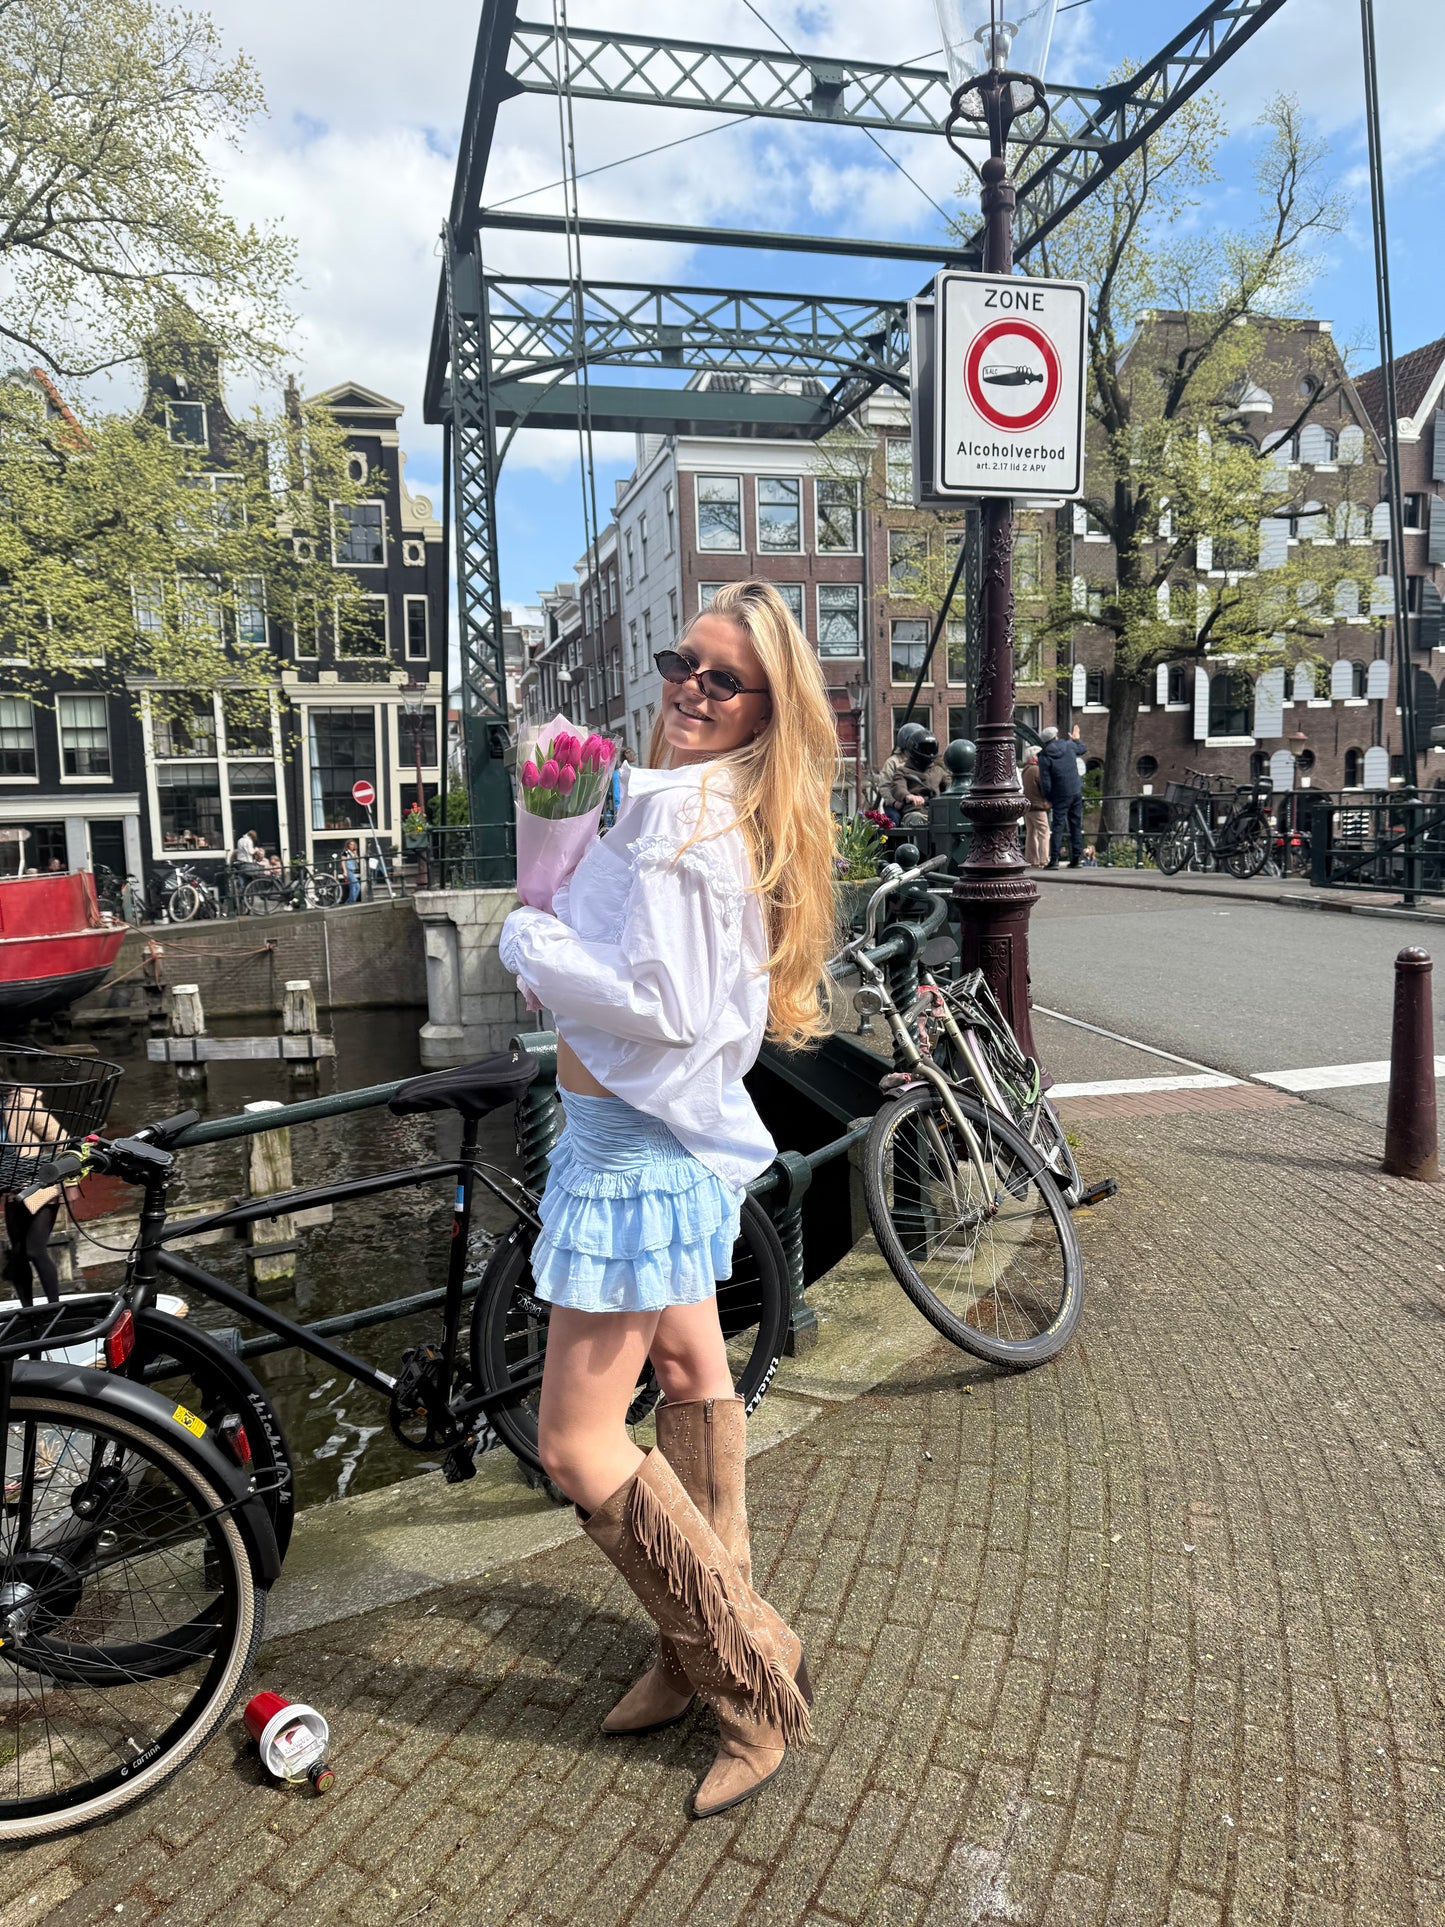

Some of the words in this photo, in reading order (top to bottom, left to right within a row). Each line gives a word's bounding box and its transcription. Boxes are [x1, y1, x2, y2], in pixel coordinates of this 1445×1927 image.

[984, 288, 1045, 312] ZONE
[956, 441, 1065, 460] Alcoholverbod
[976, 462, 991, 470] art.
[992, 462, 1008, 471] 2.17
[1010, 463, 1020, 471] lid
[1022, 464, 1028, 472] 2
[1029, 464, 1046, 472] APV
